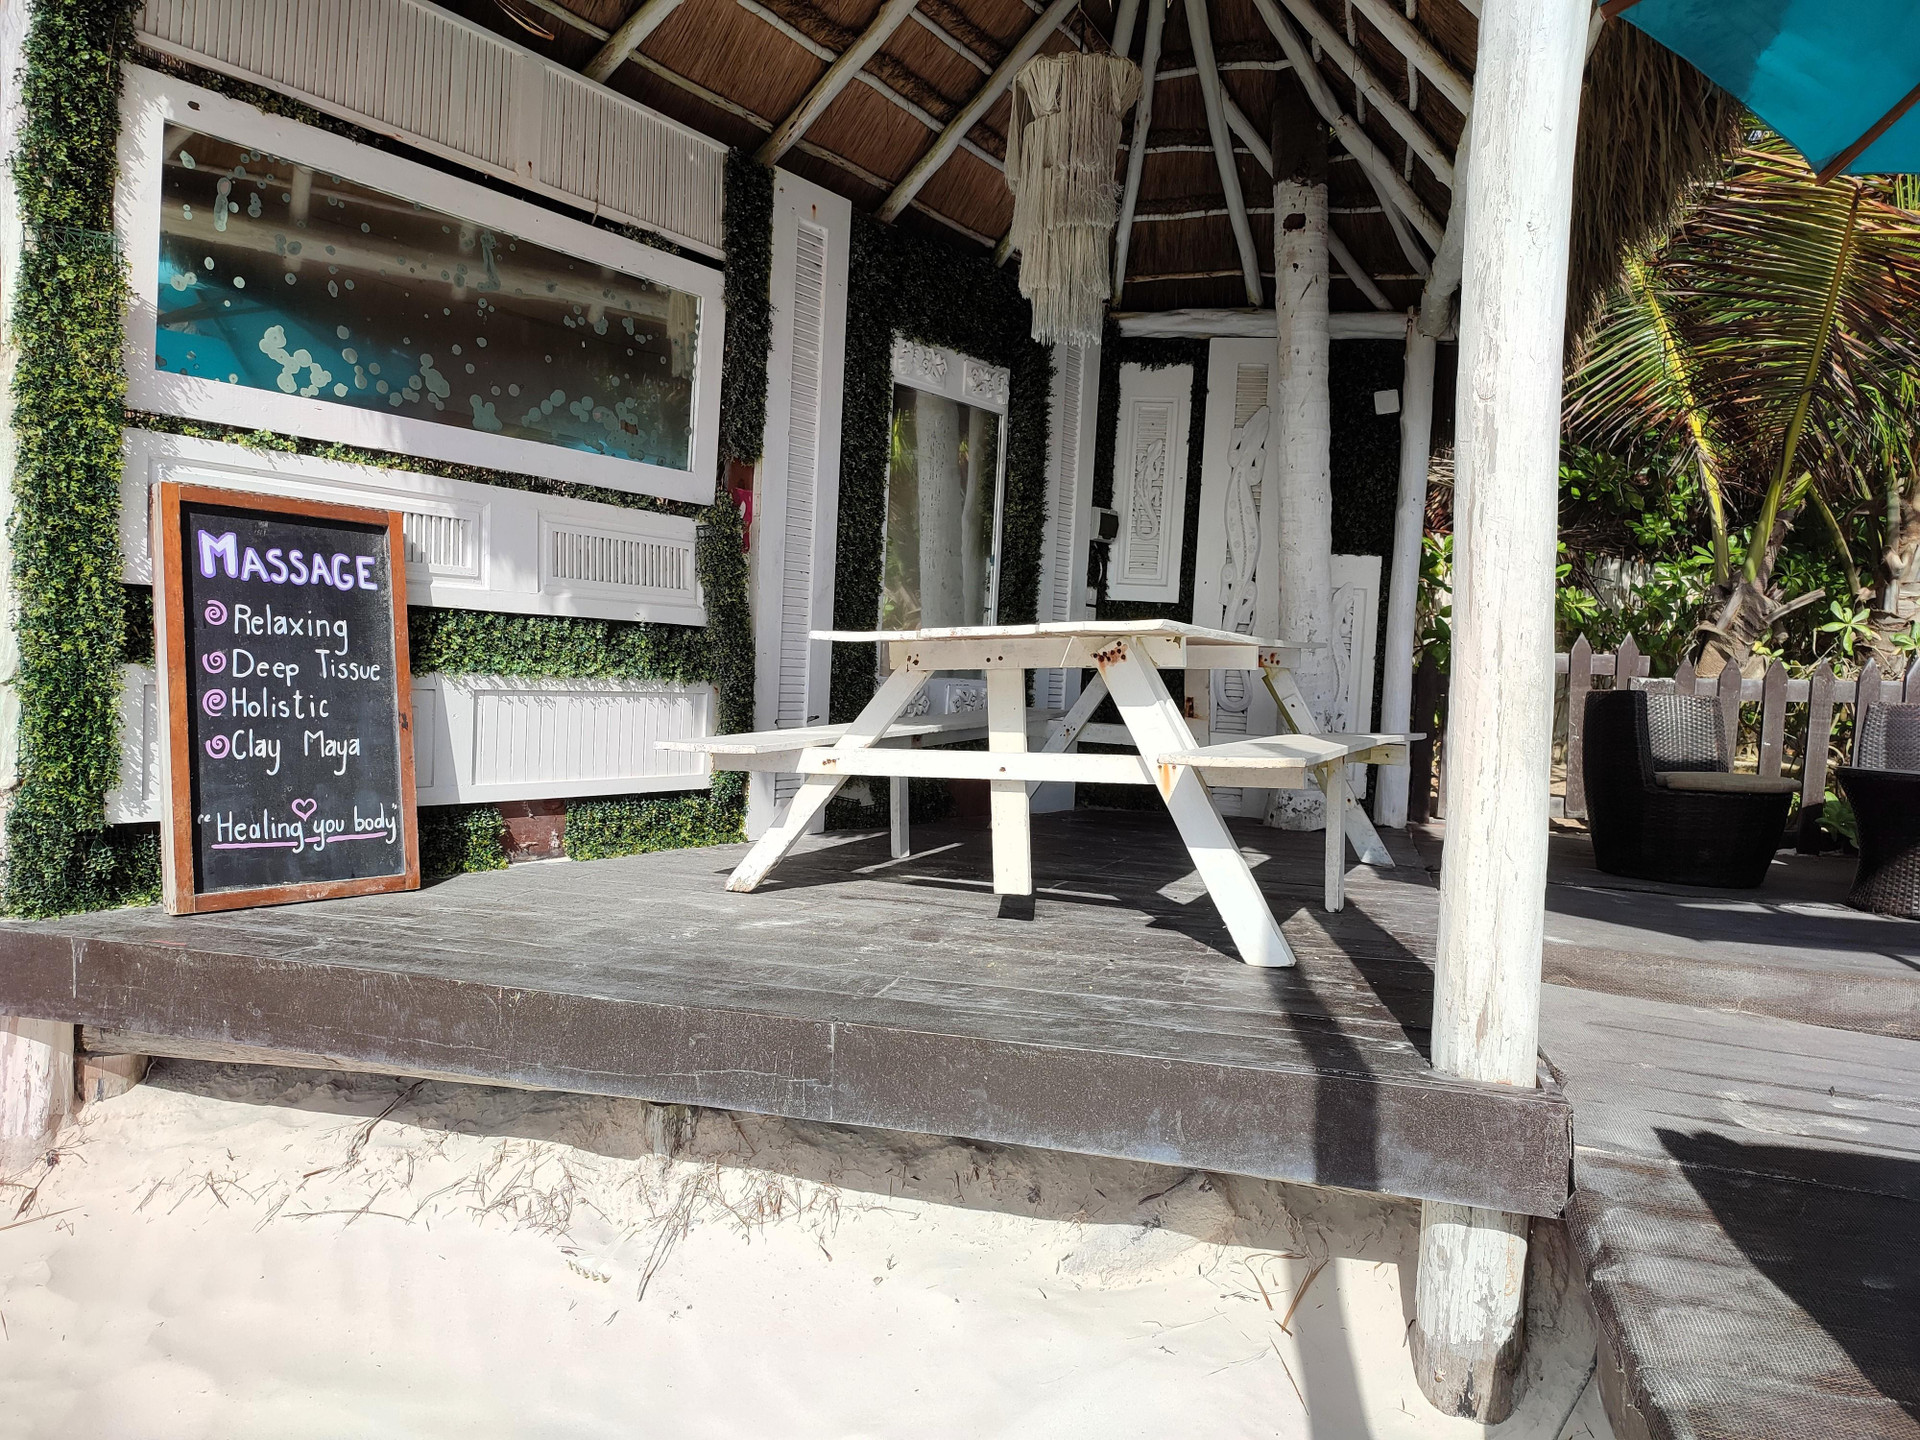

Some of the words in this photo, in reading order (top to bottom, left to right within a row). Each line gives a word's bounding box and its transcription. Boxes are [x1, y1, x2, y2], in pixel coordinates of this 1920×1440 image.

[198, 530, 378, 591] MASSAGE
[234, 604, 348, 655] Relaxing
[232, 649, 299, 687] Deep
[315, 649, 380, 681] Tissue
[232, 687, 329, 719] Holistic
[232, 730, 280, 776] Clay
[304, 730, 360, 776] Maya
[313, 818, 345, 851] you
